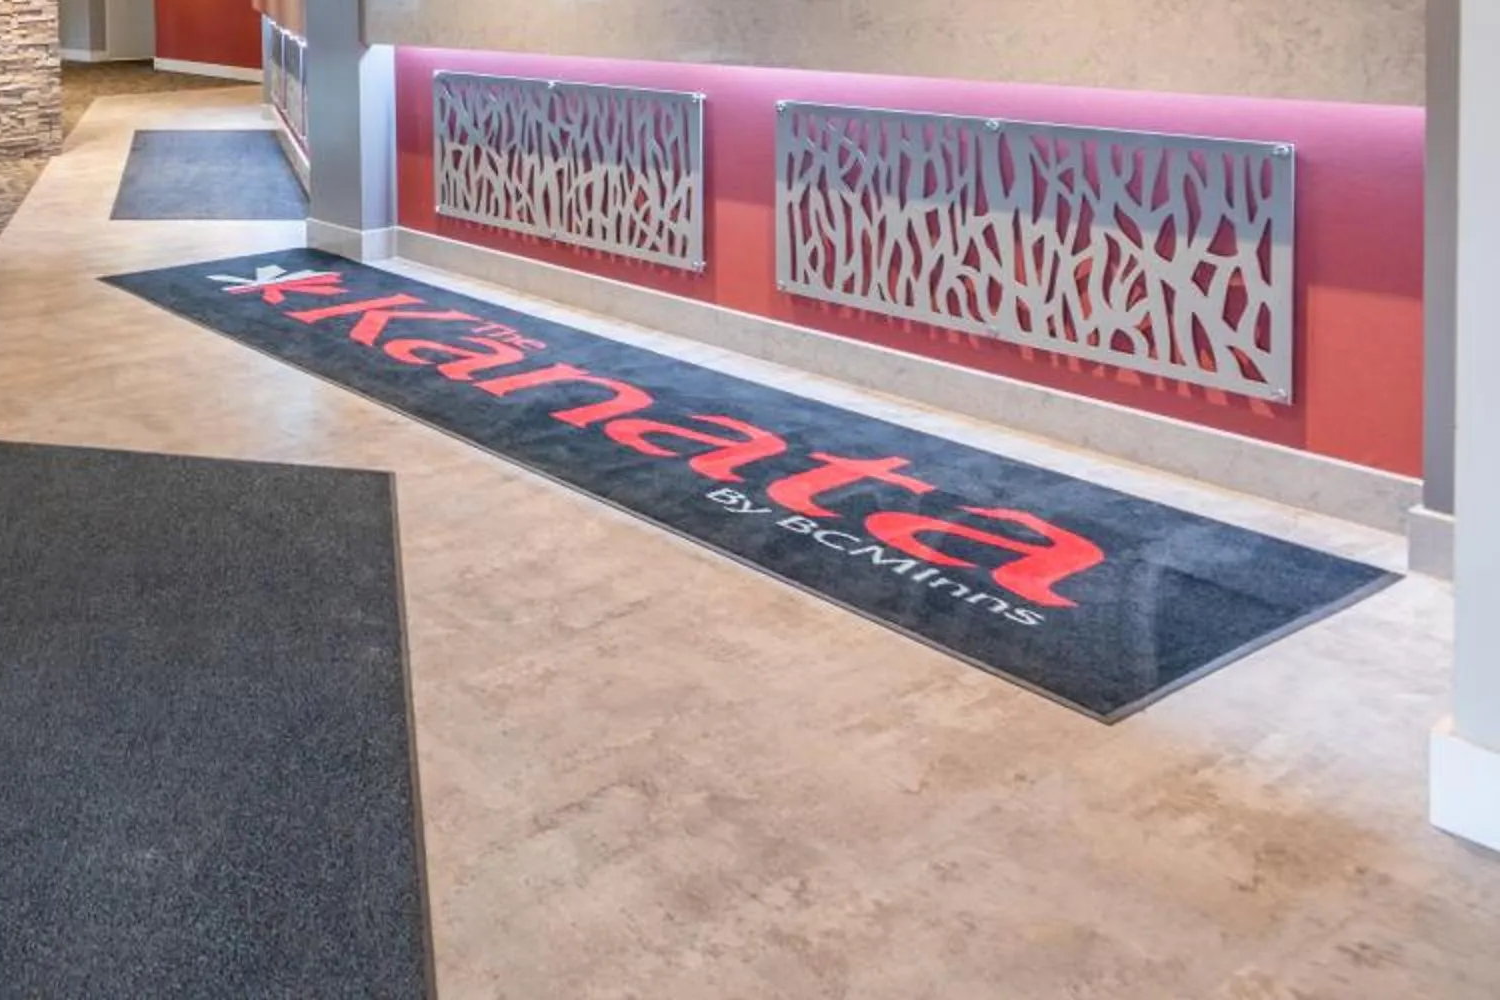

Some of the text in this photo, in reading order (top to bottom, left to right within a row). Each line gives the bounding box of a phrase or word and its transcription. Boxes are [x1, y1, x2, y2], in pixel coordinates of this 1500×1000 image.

[470, 319, 547, 350] The
[283, 293, 1105, 608] Kanata
[705, 487, 1046, 627] By BCMInns
